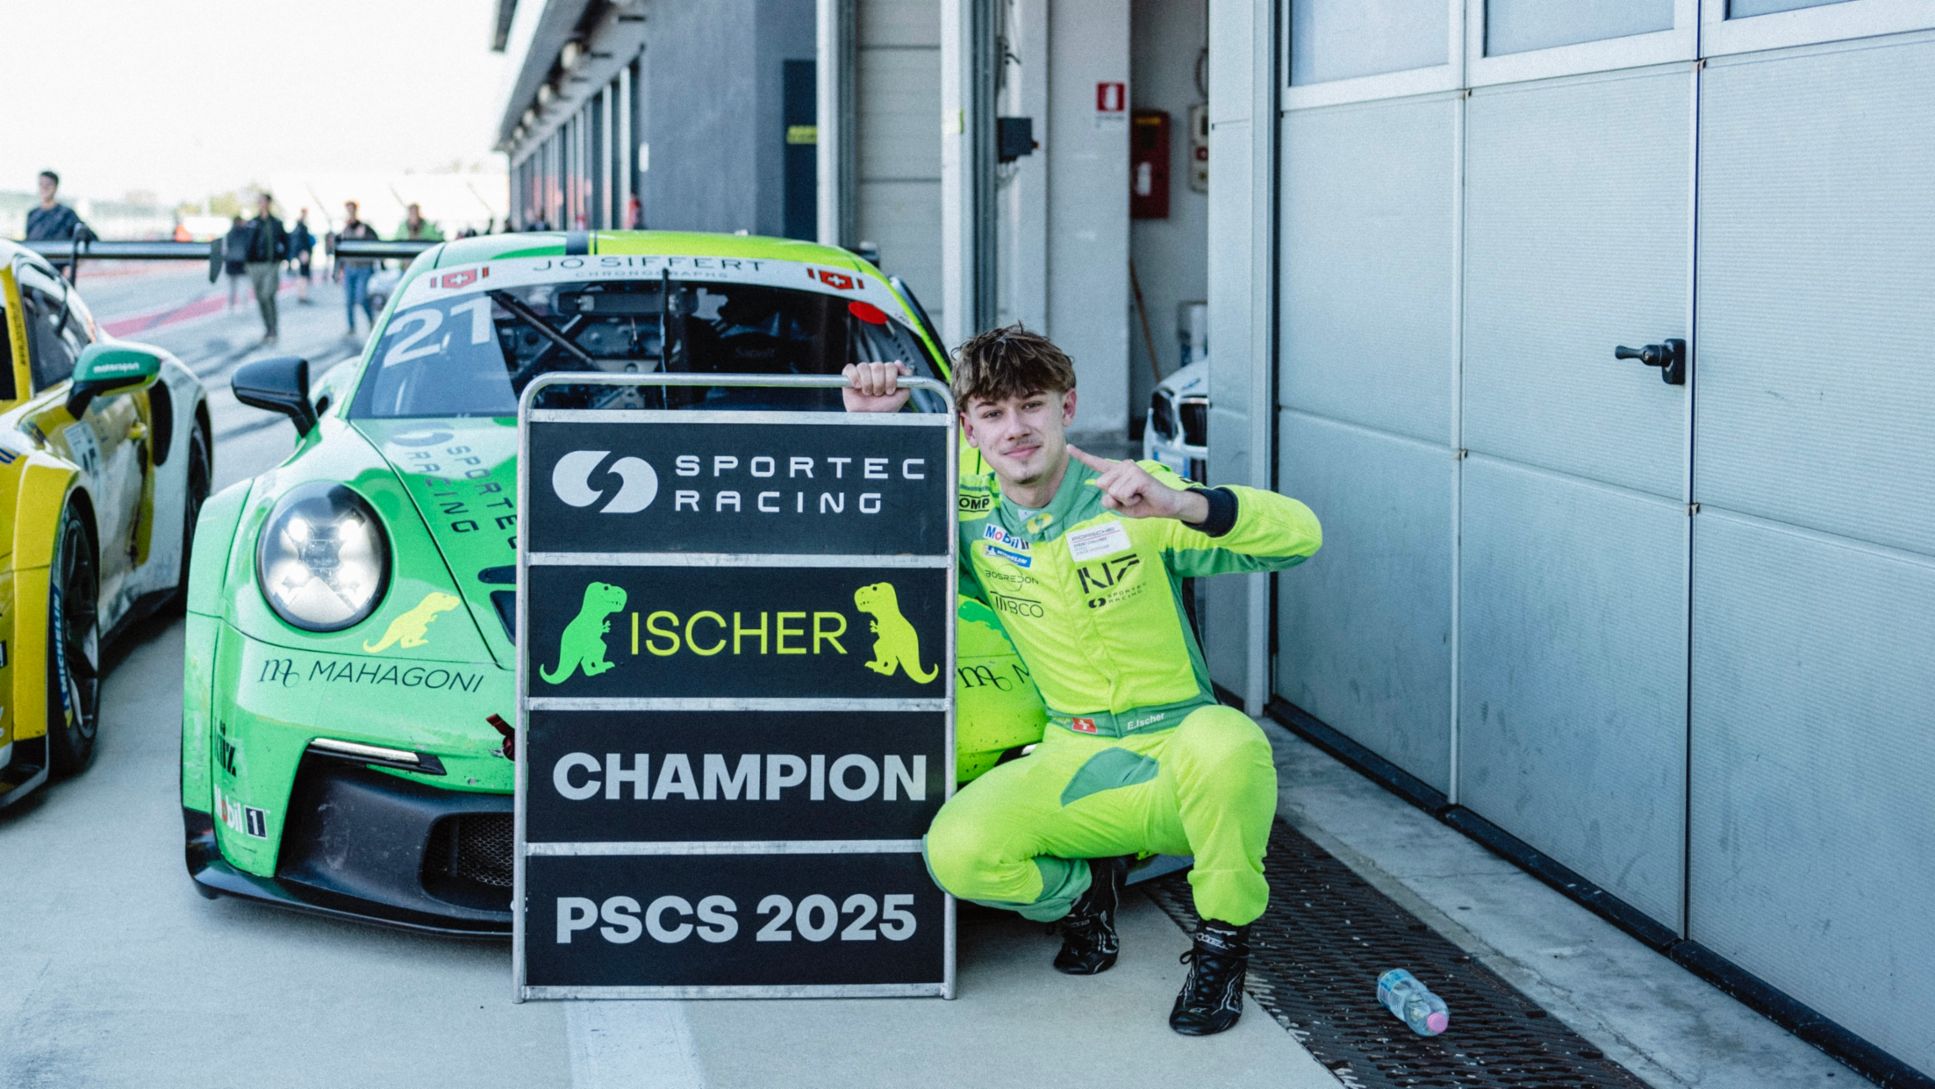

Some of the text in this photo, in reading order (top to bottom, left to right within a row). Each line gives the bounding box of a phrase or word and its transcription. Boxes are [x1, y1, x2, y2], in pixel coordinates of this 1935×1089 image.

[533, 255, 766, 272] JO SIFFERT
[382, 295, 492, 369] 21
[674, 454, 926, 480] SPORTEC
[674, 489, 882, 514] RACING
[959, 497, 990, 509] OMP
[985, 525, 1019, 549] Mobil
[53, 592, 68, 693] MICHELIN
[630, 609, 849, 657] ISCHER
[308, 659, 485, 693] MAHAGONI
[551, 751, 928, 802] CHAMPION
[213, 783, 244, 835] Mobil
[556, 893, 918, 945] PSCS 2025
